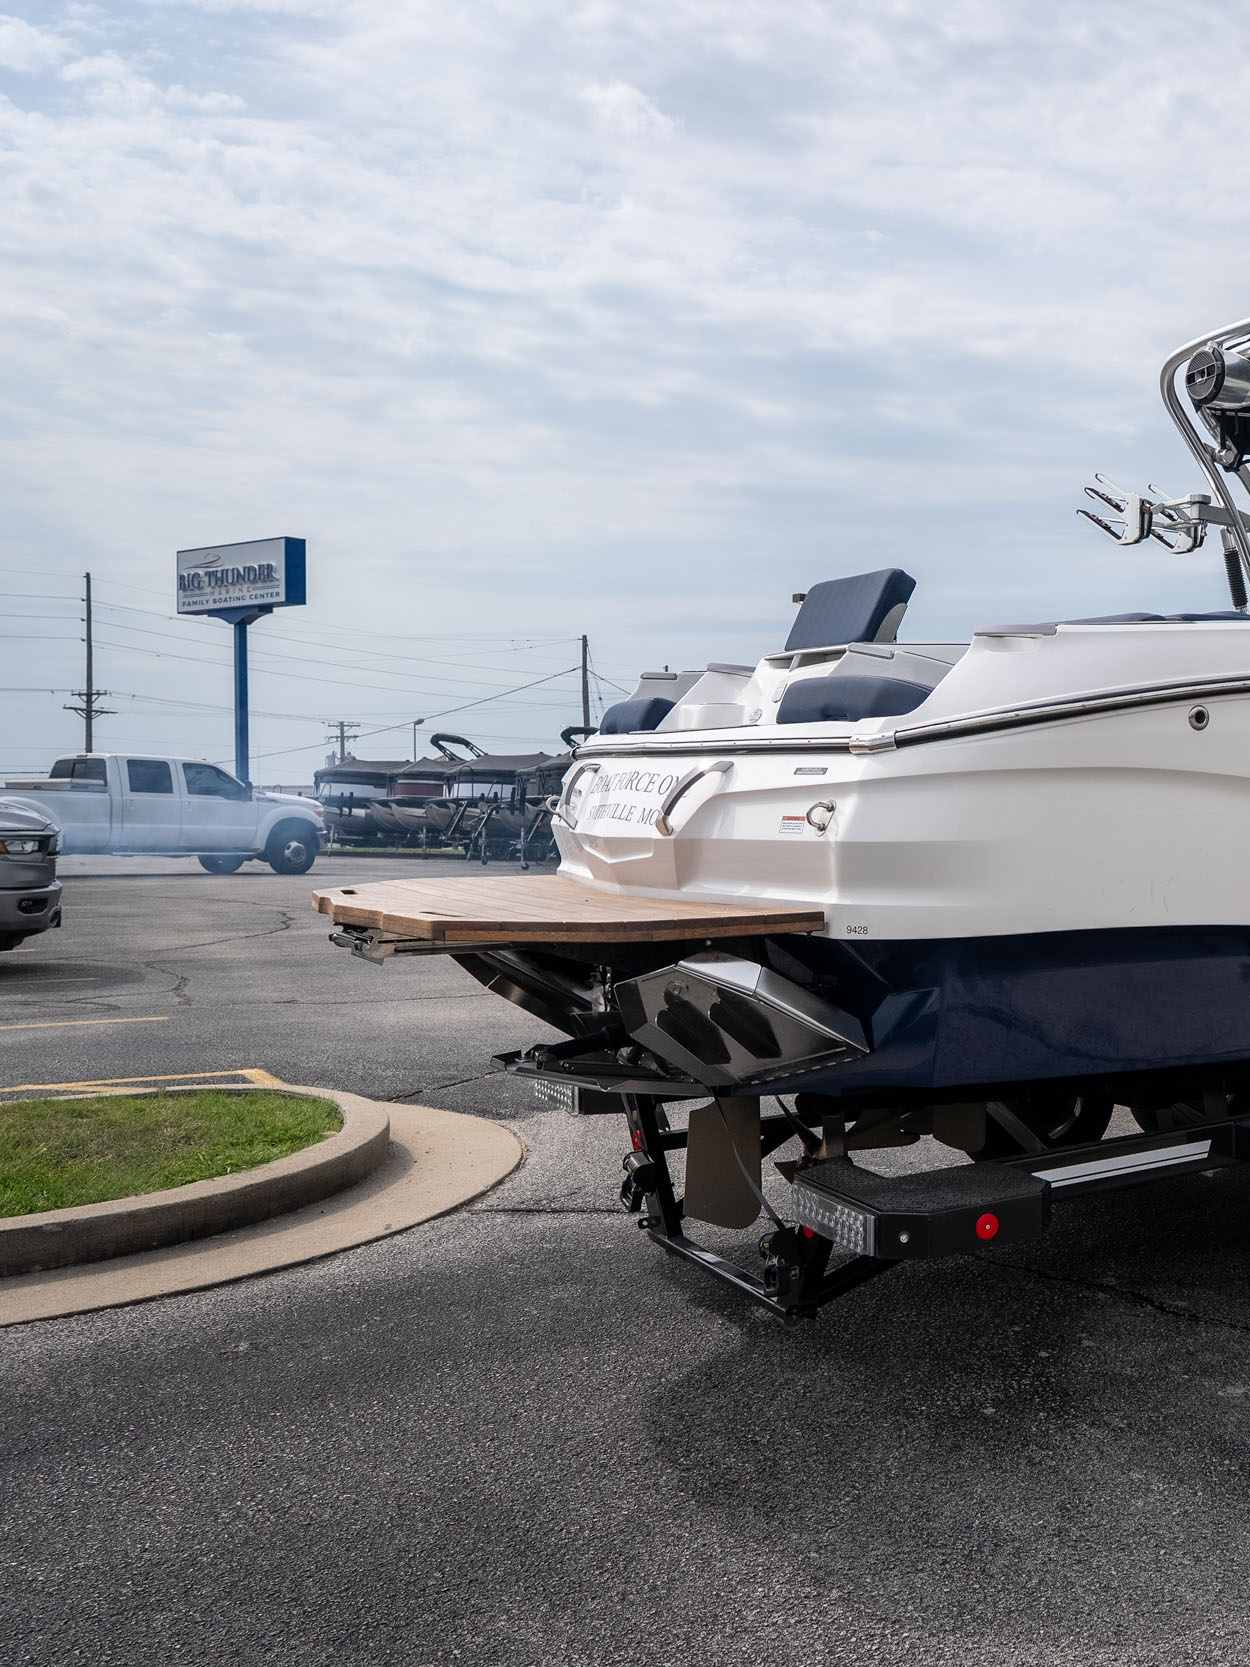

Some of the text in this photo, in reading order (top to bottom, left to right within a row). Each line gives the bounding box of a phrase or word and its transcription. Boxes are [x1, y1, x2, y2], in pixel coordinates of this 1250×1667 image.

[179, 563, 278, 592] BIG THUNDER
[209, 586, 252, 597] MARINE
[182, 591, 281, 607] FAMILY BOATING CENTER
[846, 925, 869, 935] 9428
